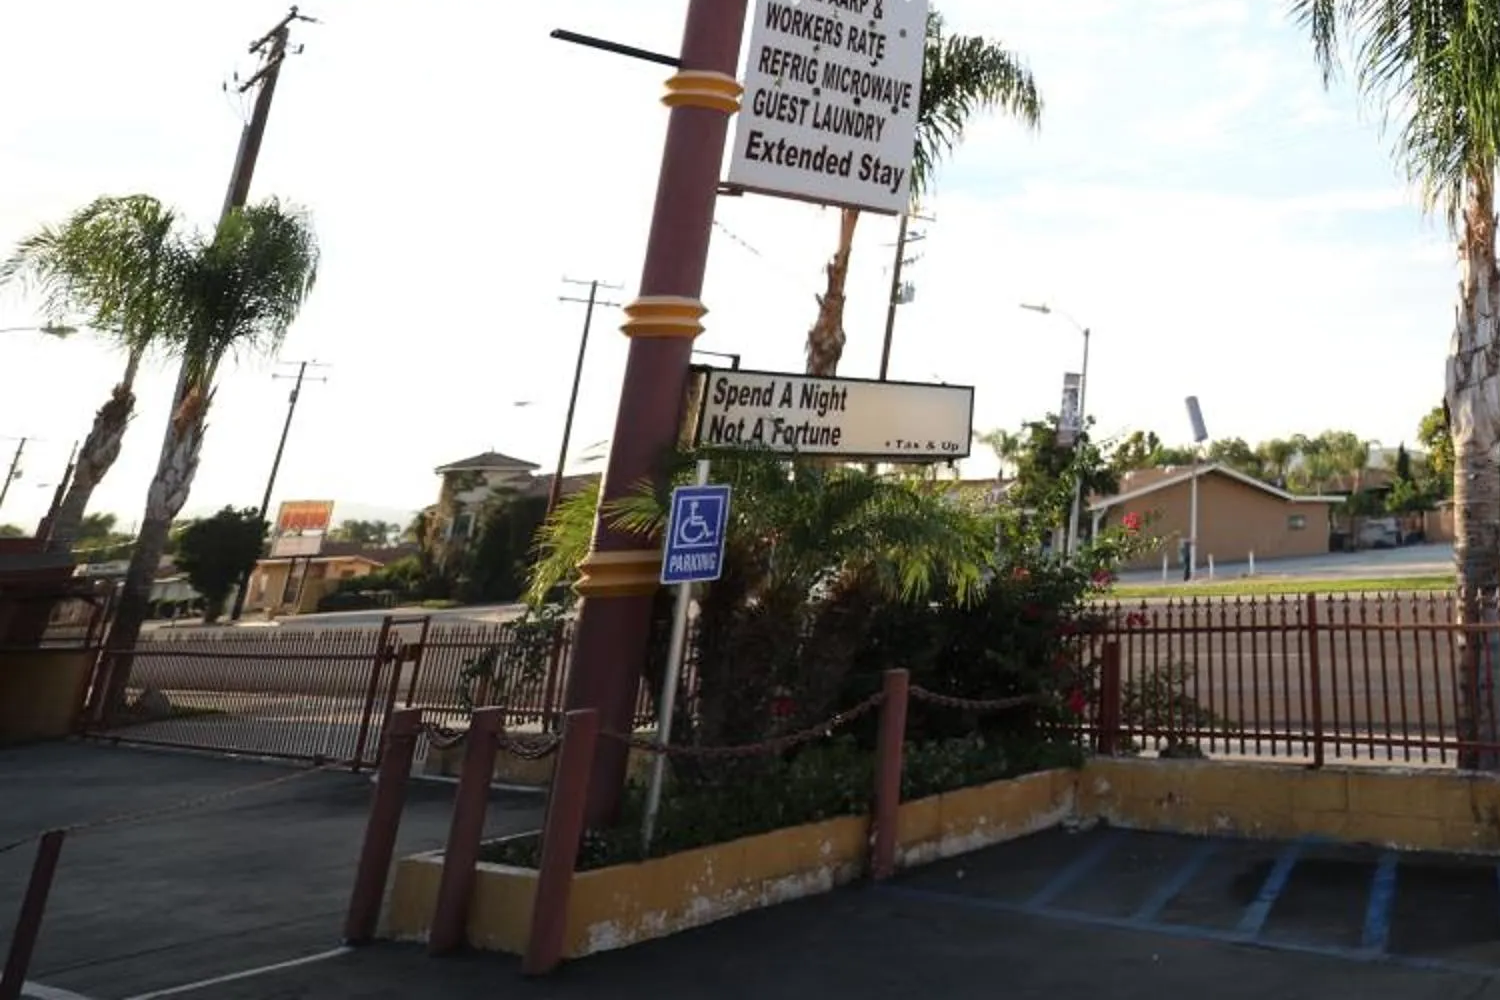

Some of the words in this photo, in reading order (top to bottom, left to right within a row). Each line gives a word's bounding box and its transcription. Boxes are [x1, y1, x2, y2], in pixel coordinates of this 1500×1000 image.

[765, 2, 843, 48] WORKERS
[847, 26, 887, 60] RATE
[758, 45, 818, 85] REFRIG
[822, 61, 913, 109] MICROWAVE
[753, 88, 810, 125] GUEST
[812, 102, 886, 142] LAUNDRY
[745, 130, 853, 177] Extended
[858, 153, 904, 194] Stay
[713, 377, 775, 411] Spend
[779, 381, 793, 408] A
[800, 383, 847, 417] Night
[709, 415, 745, 444] Not
[752, 417, 763, 443] A
[771, 417, 841, 446] Fortune
[669, 552, 717, 573] PARKING
